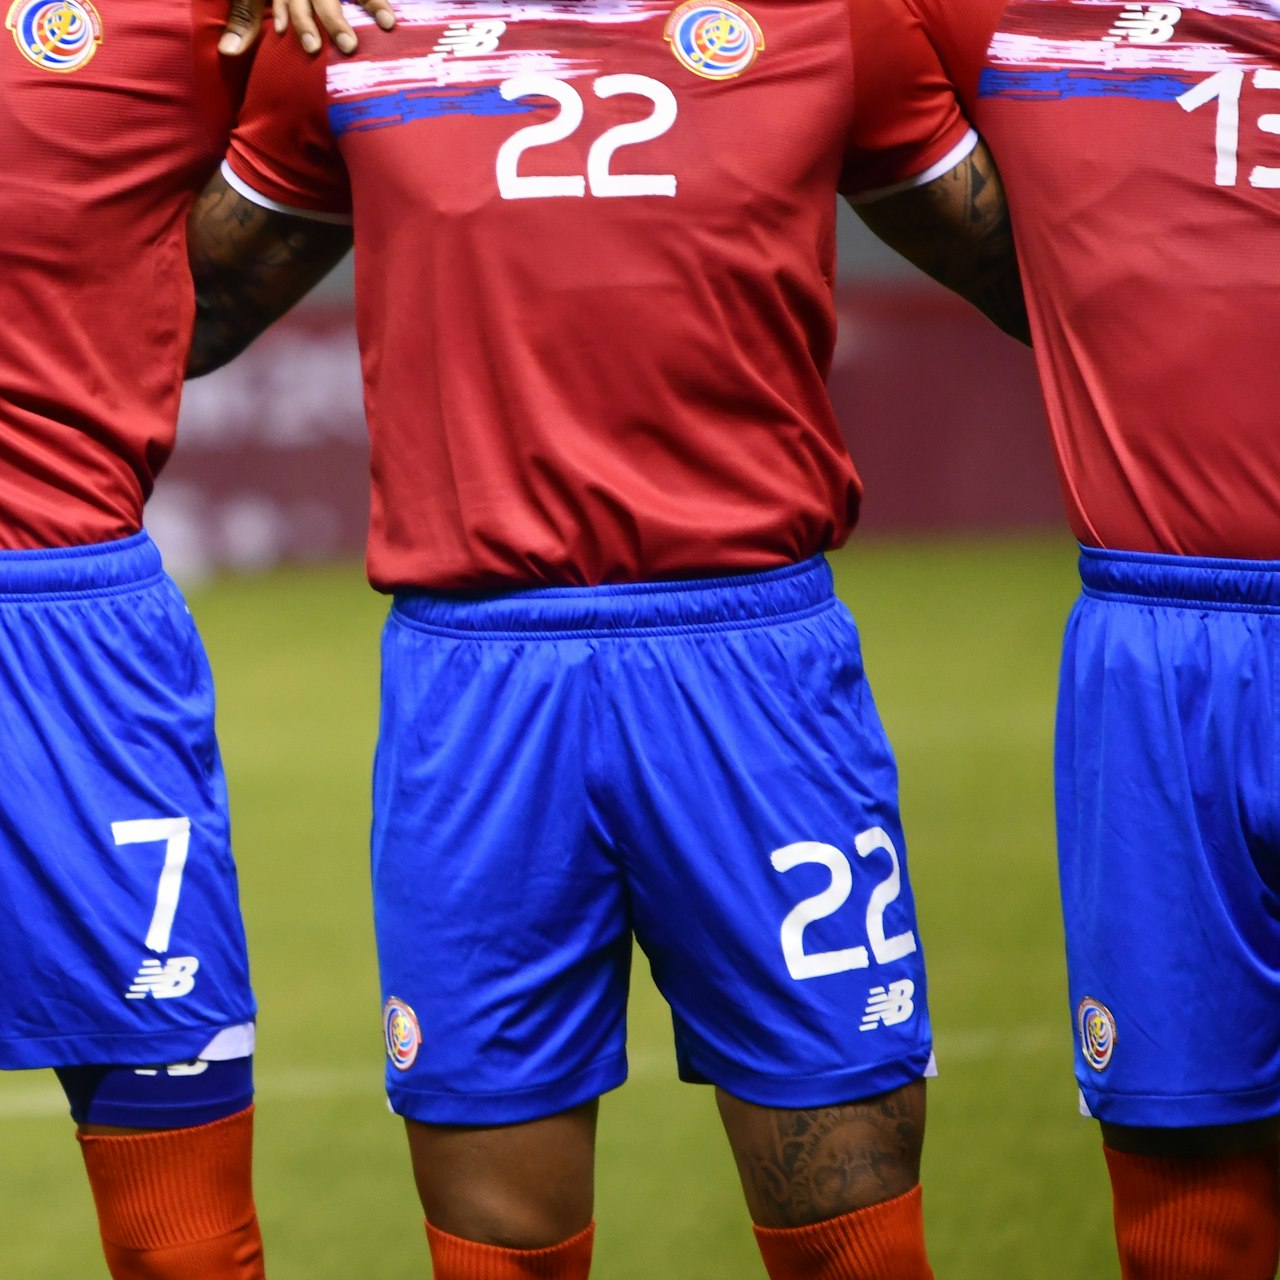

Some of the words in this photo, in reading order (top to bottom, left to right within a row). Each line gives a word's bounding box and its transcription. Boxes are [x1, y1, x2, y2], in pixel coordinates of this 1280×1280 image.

[495, 73, 678, 200] 22
[110, 816, 191, 953] 7
[769, 826, 917, 982] 22
